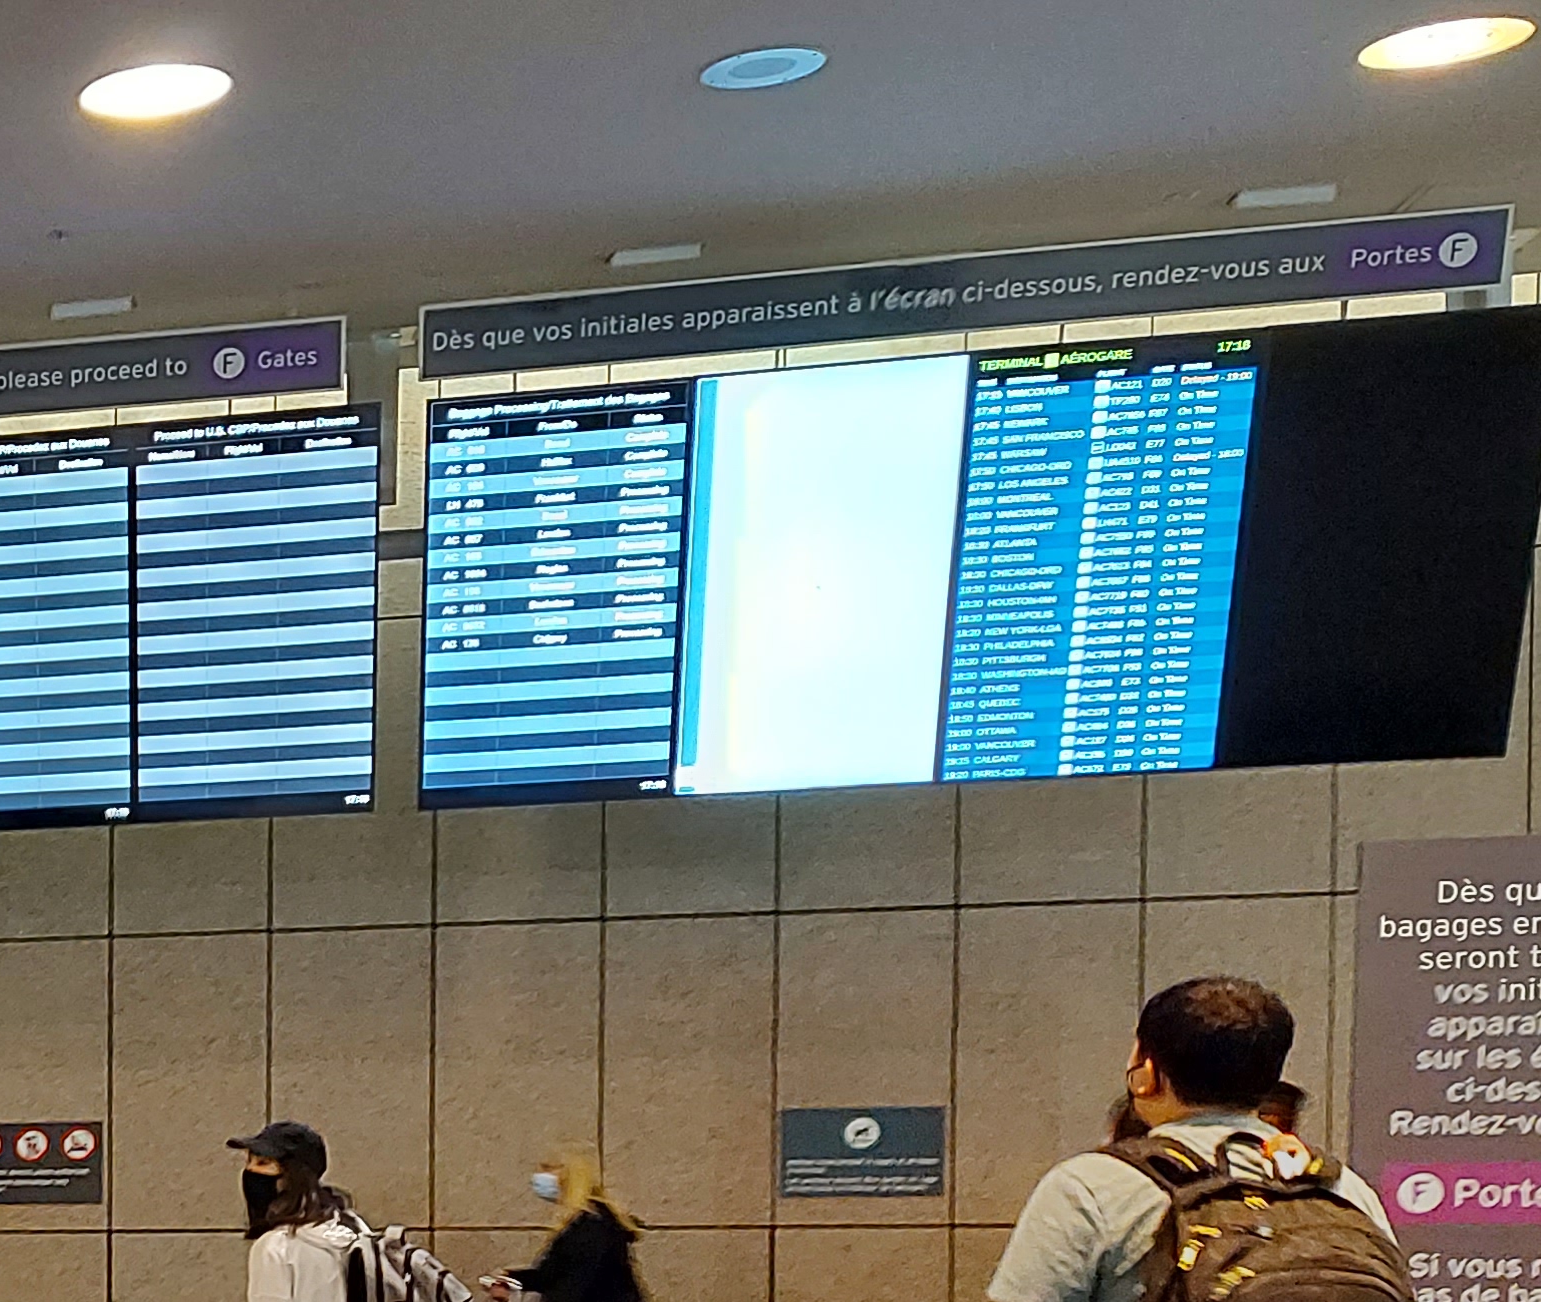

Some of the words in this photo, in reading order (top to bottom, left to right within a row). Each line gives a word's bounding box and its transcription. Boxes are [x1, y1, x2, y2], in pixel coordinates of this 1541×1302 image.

[1350, 244, 1432, 269] Portes
[432, 329, 475, 352] Dès
[482, 328, 525, 350] que
[532, 324, 573, 342] vos
[580, 312, 674, 338] initiales
[681, 294, 840, 331] apparaissent
[847, 292, 862, 313] à
[869, 286, 957, 312] l'écran
[962, 275, 1103, 303] ci-dessous,
[1111, 259, 1270, 289] rendez-vous
[1278, 254, 1326, 275] aux
[257, 348, 318, 369] Gates
[979, 357, 1043, 372] TERMINAL
[1060, 349, 1133, 365] AÉROGARE
[70, 358, 158, 388] proceed
[165, 357, 188, 376] to
[1437, 878, 1494, 904] Dès
[1379, 914, 1503, 943] bagages
[1418, 945, 1520, 970] seront
[1434, 983, 1490, 1004] vos
[1497, 977, 1541, 1003] ini
[1415, 1048, 1470, 1071] sur
[1476, 1044, 1522, 1070] les
[1408, 1252, 1441, 1279] Si
[1447, 1258, 1523, 1279] vous
